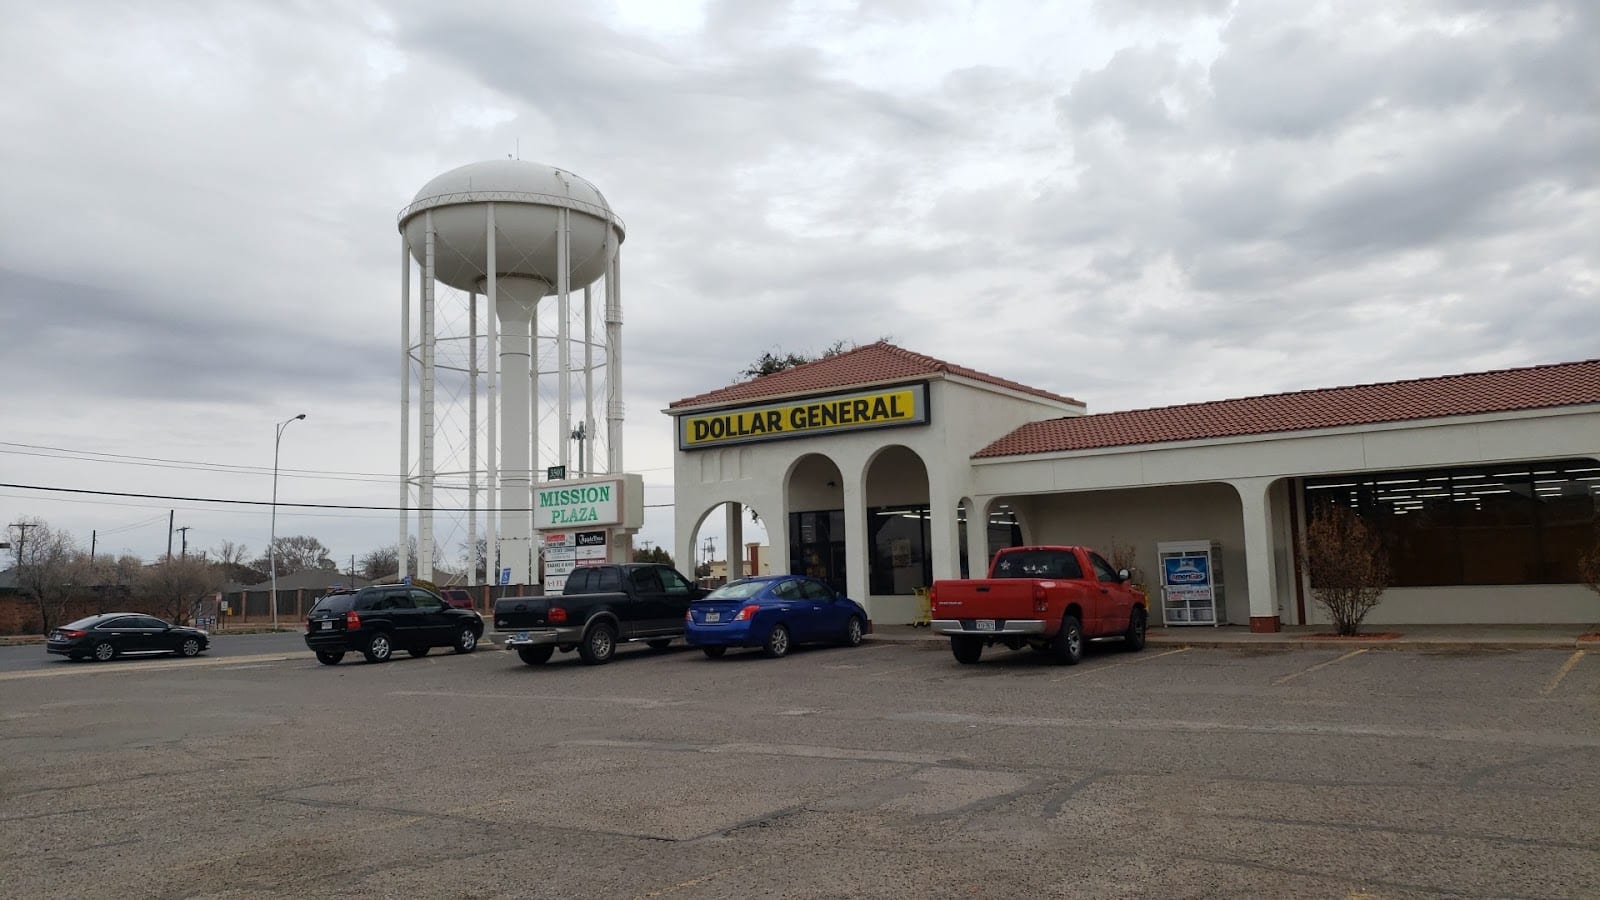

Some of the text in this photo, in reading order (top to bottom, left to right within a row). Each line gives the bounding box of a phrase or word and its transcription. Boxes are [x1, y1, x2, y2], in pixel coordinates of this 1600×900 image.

[694, 395, 905, 441] DOLLAR GENERAL
[540, 486, 610, 507] MISSION
[551, 507, 598, 524] PLAZA
